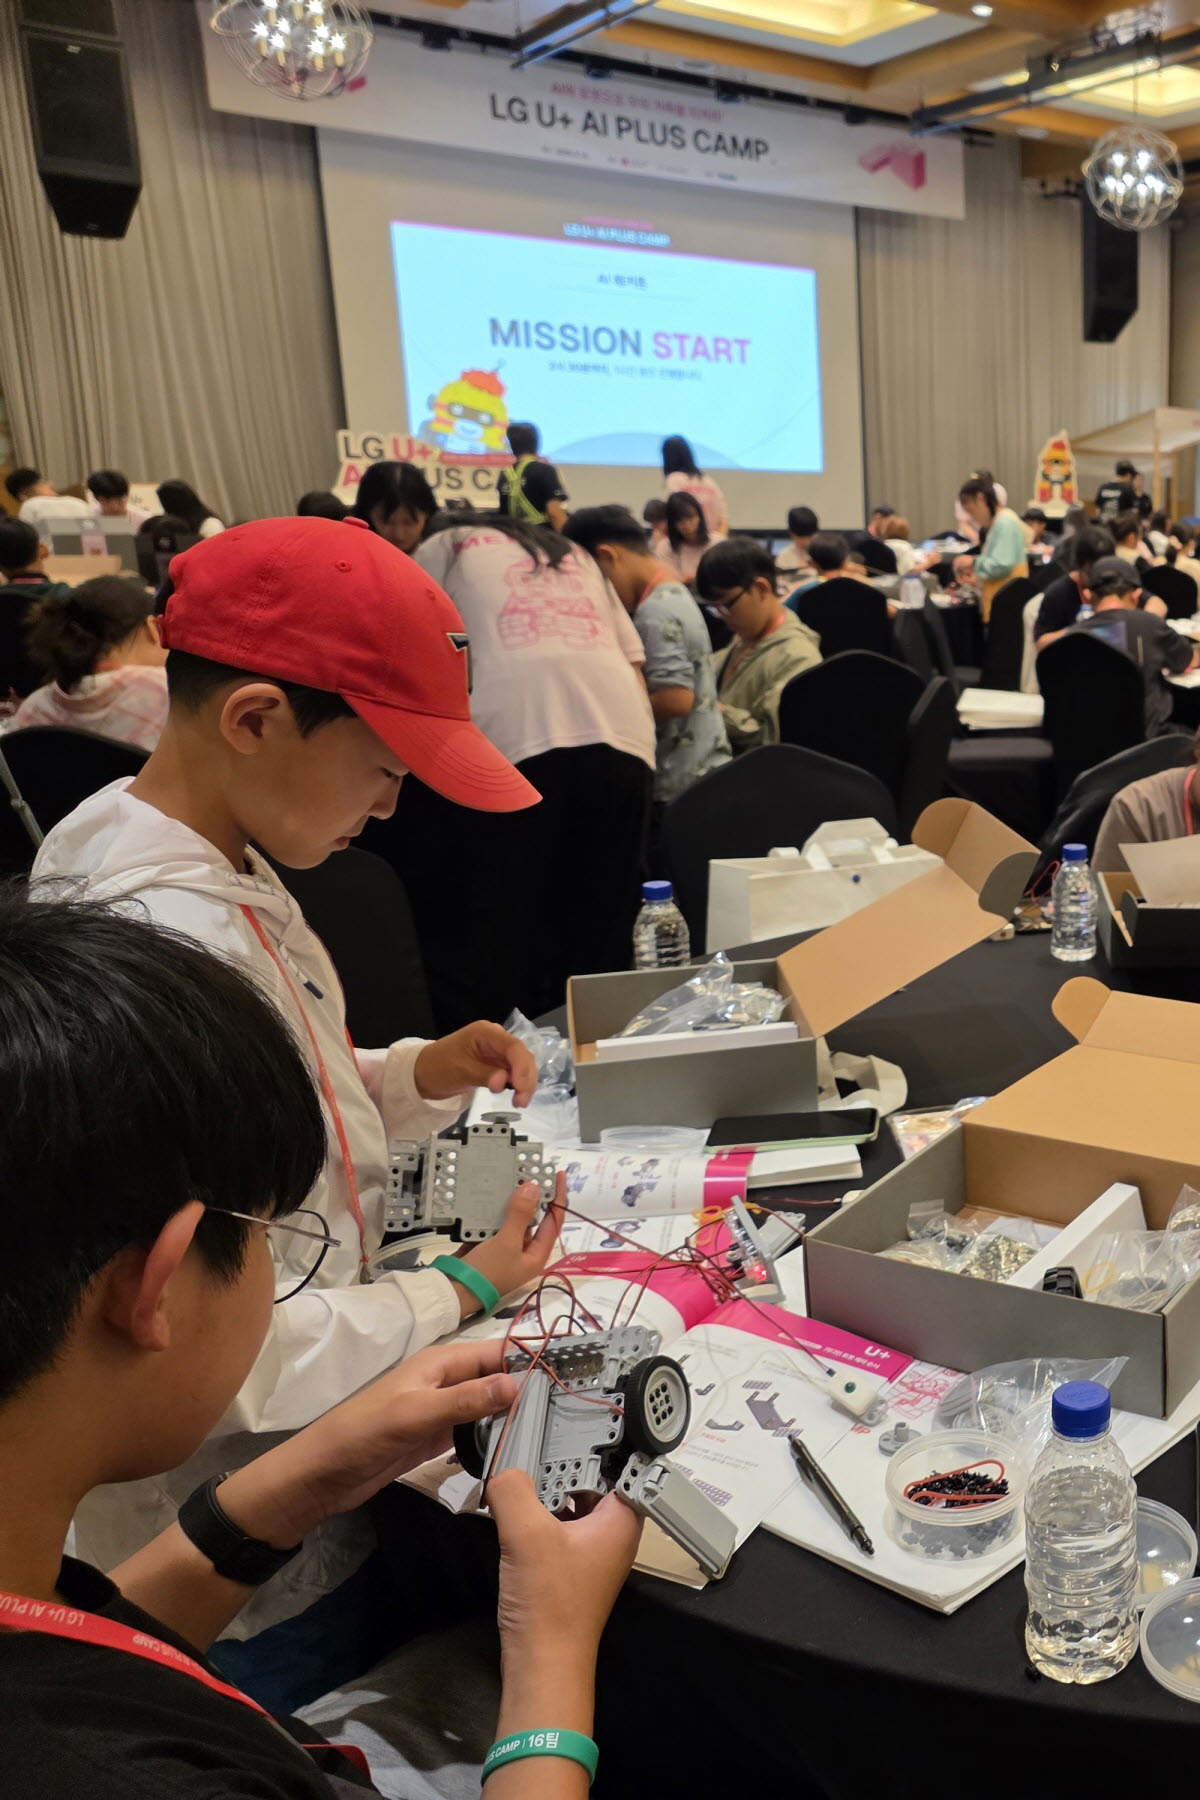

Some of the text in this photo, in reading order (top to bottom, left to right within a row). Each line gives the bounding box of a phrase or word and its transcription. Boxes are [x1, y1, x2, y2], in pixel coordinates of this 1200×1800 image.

[490, 93, 531, 124] LG
[535, 98, 572, 130] U+
[581, 106, 608, 138] AI
[615, 114, 687, 152] PLUS
[694, 127, 770, 163] CAMP
[489, 317, 752, 365] MISSION START
[344, 436, 384, 460] LG
[392, 438, 433, 462] U+
[864, 1346, 891, 1359] U+
[29, 1603, 46, 1617] AI
[48, 1608, 67, 1624] U+
[67, 1611, 85, 1627] LG
[132, 1633, 161, 1654] CAMP
[496, 1740, 520, 1758] CAMP
[528, 1732, 559, 1749] 16팀
